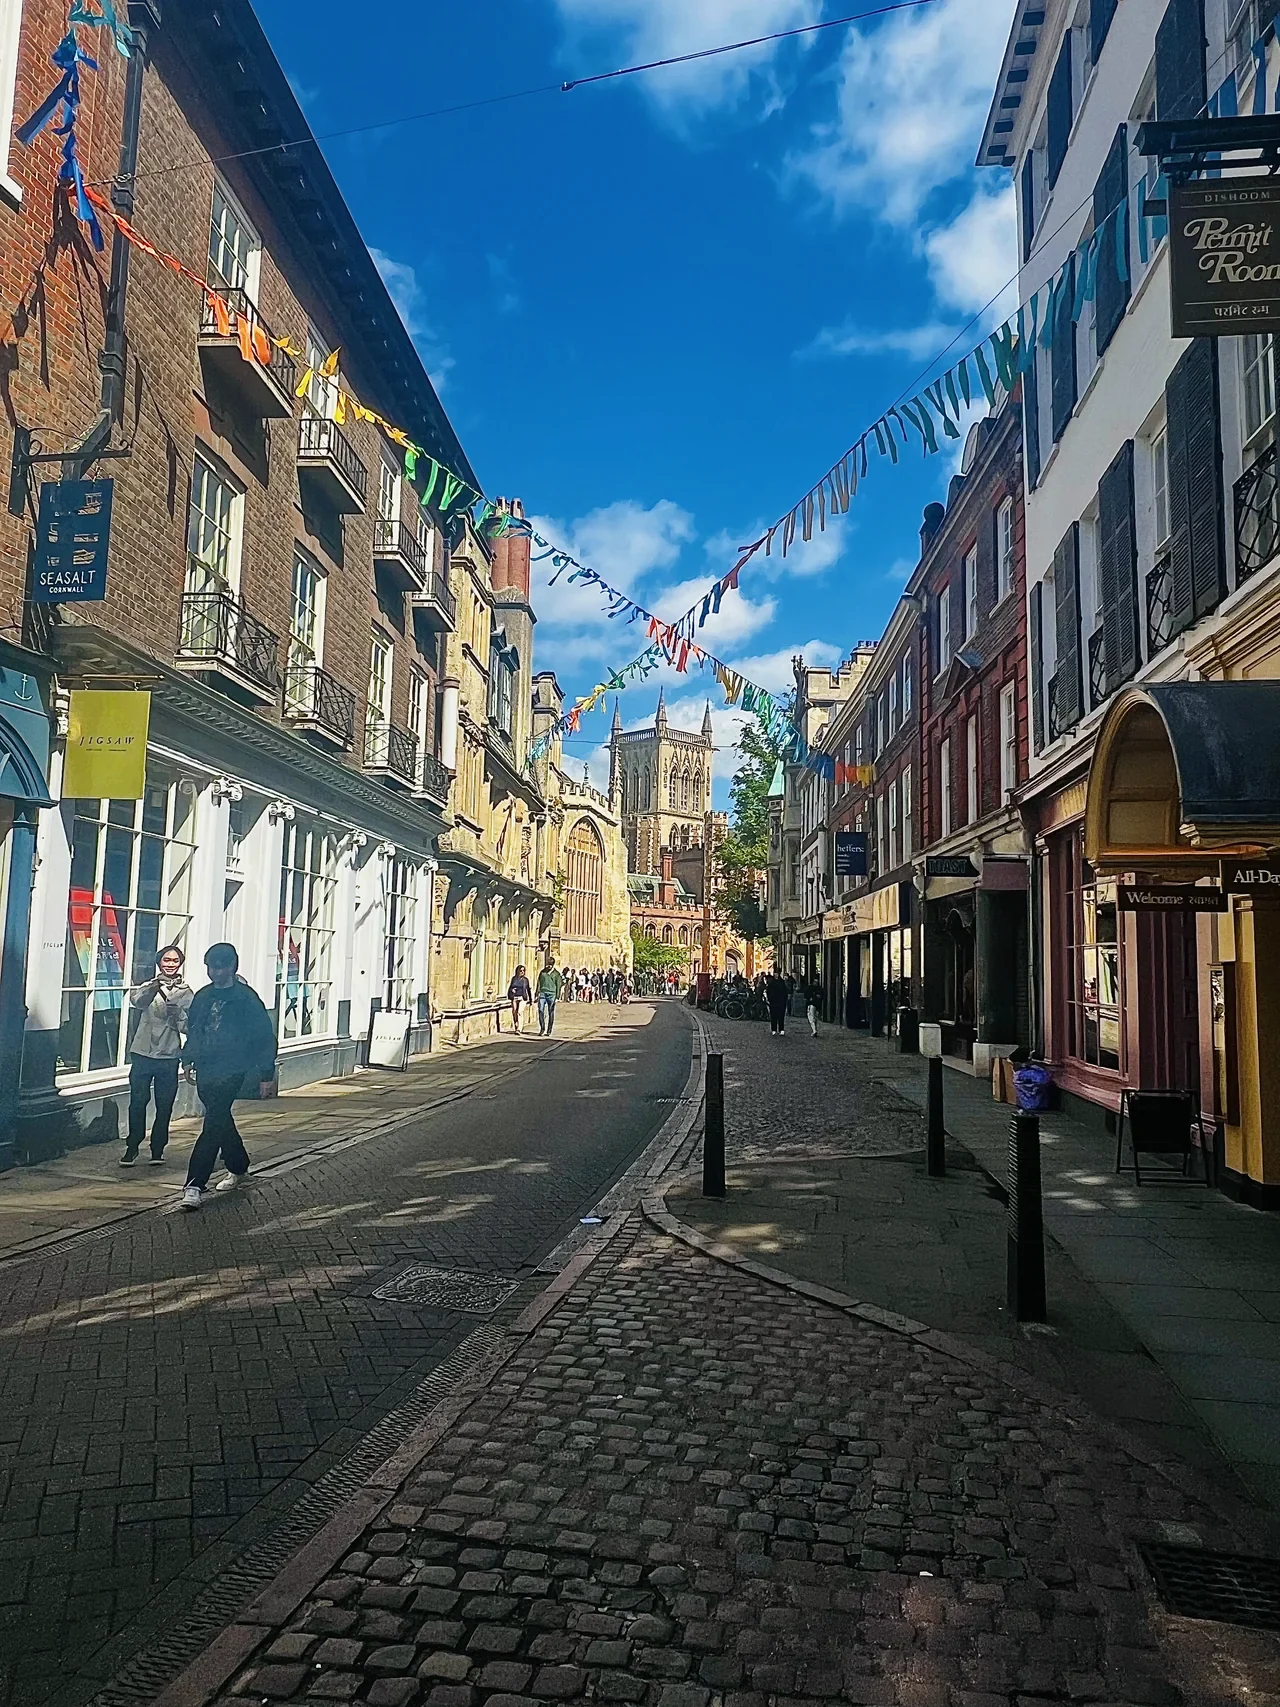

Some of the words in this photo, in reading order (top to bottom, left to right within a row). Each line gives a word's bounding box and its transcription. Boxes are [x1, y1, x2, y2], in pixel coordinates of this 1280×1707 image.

[1204, 191, 1271, 202] DISHOOM
[1183, 217, 1274, 254] Permit
[39, 570, 96, 586] SEASALT
[49, 586, 85, 594] CORNWALL
[79, 736, 135, 747] JIGSAW
[928, 858, 968, 874] TOAST
[1126, 891, 1183, 905] Welcome
